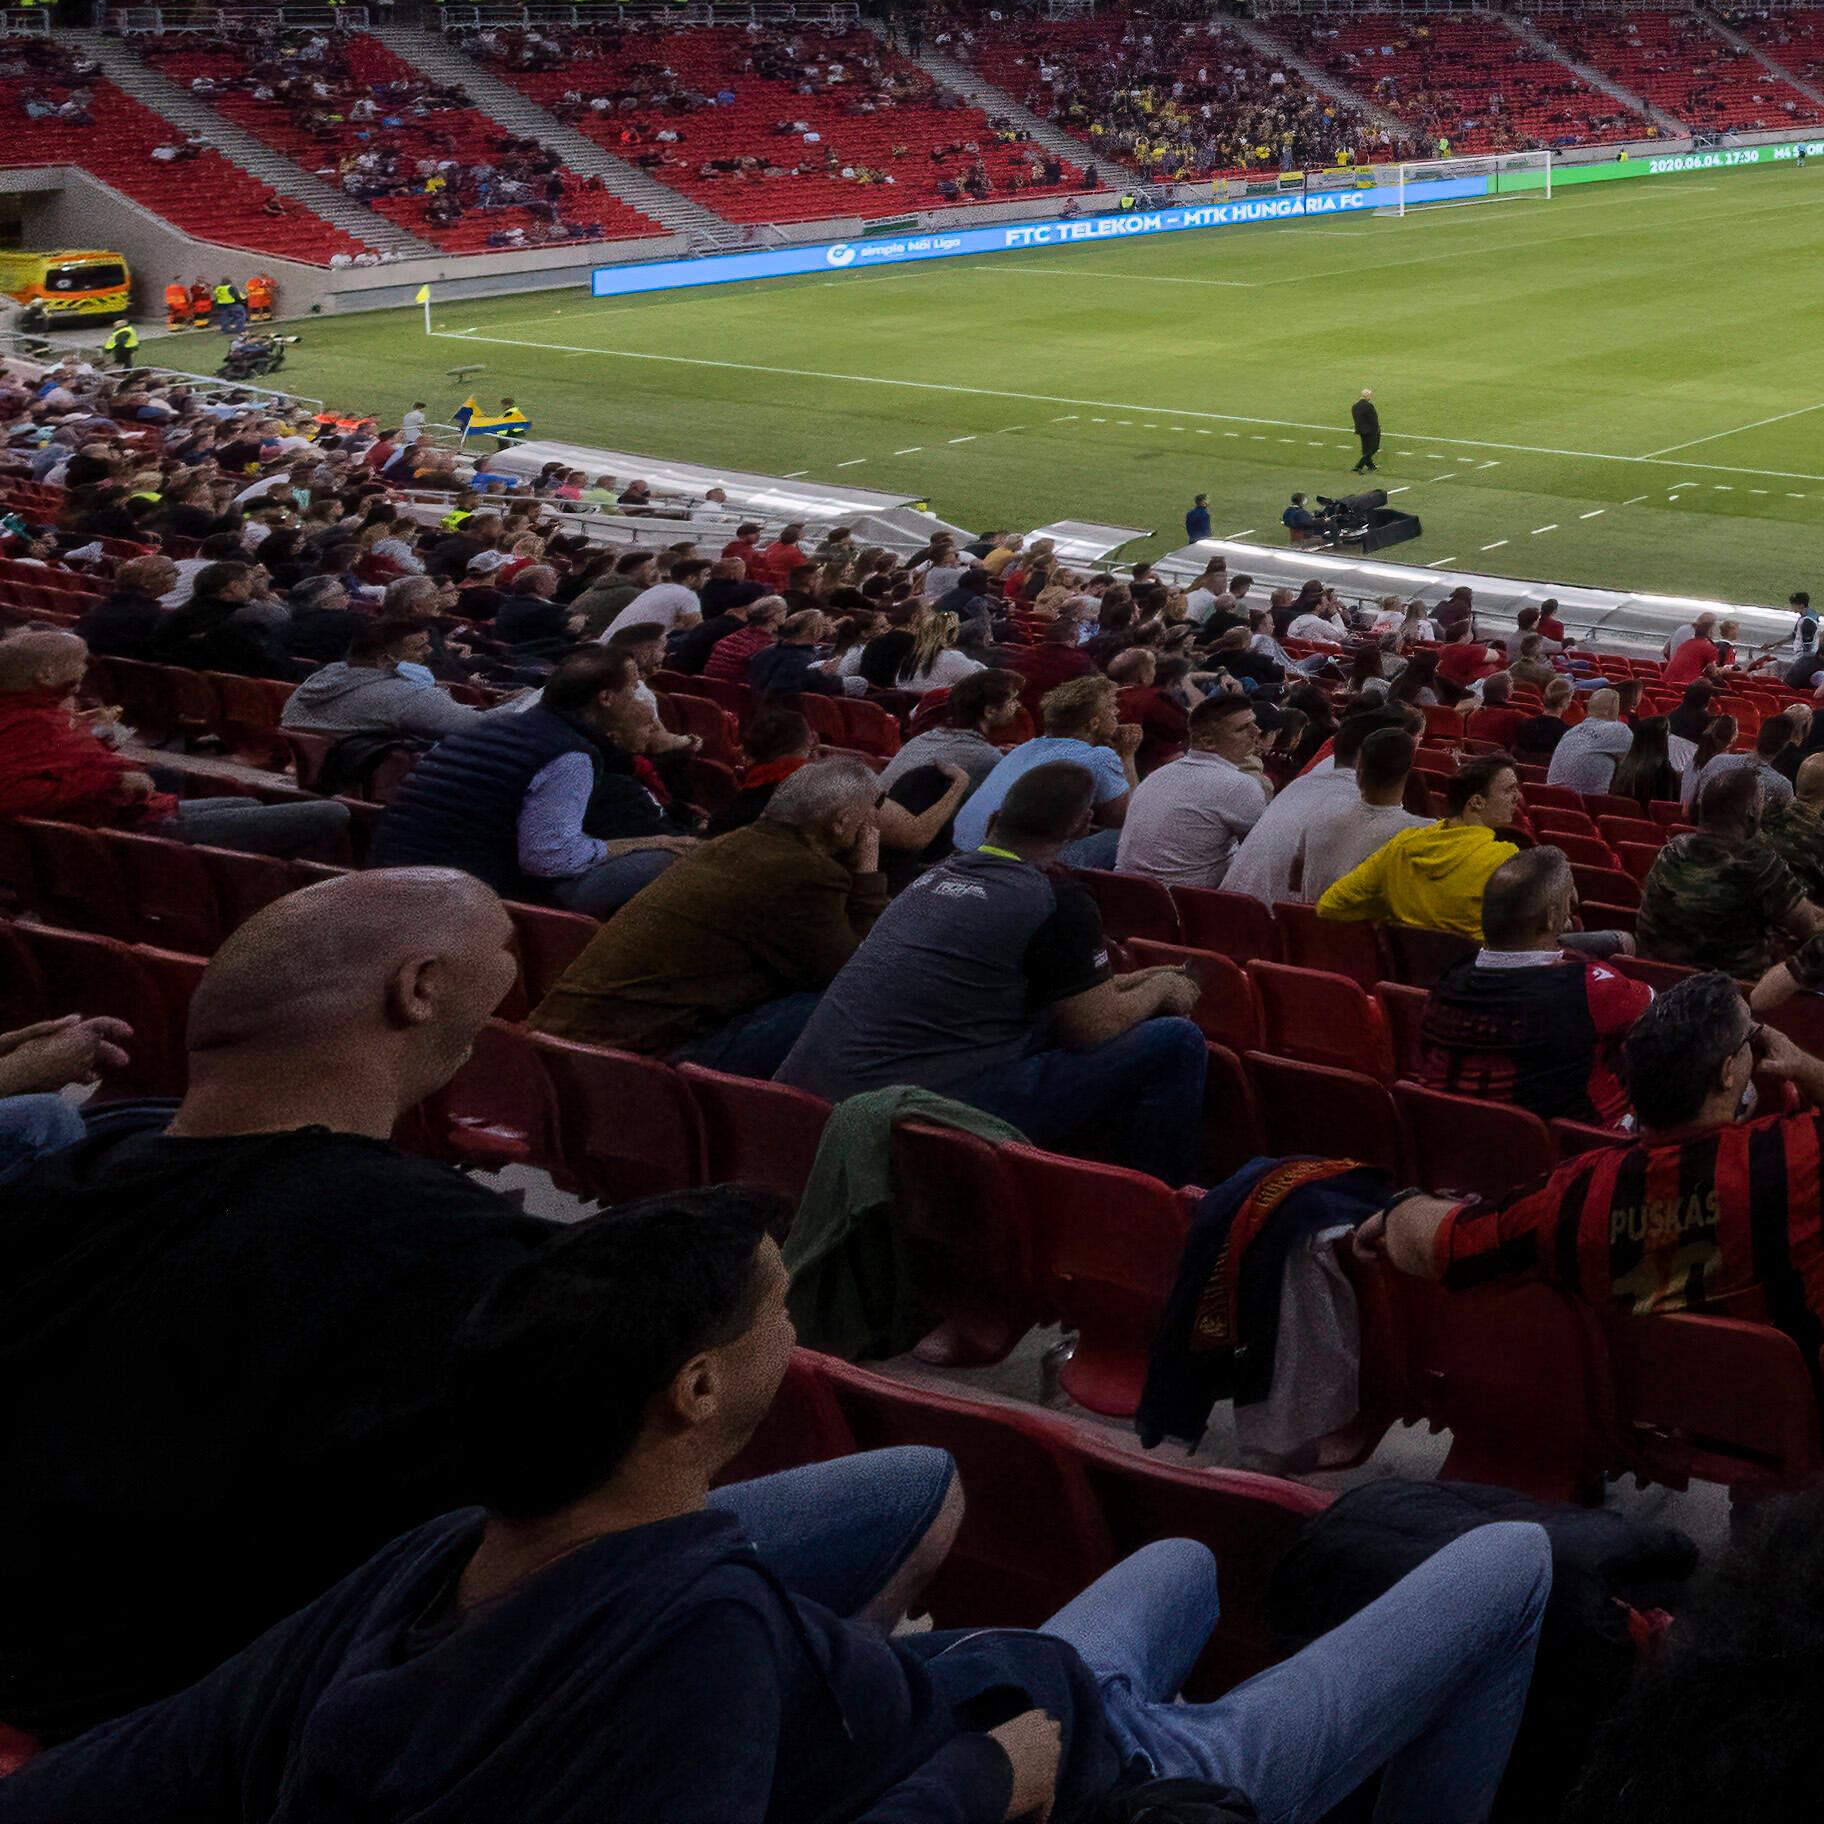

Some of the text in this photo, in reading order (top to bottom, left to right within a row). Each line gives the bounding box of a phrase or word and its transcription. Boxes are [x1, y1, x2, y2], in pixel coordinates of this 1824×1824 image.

[1006, 226, 1052, 246] FTC
[1056, 215, 1162, 241] TELEKOM
[1183, 208, 1228, 227] MTK
[1231, 195, 1337, 222] HUNGÁRIA
[1339, 192, 1364, 209] FC
[1610, 1178, 1721, 1245] PUSKÁS
